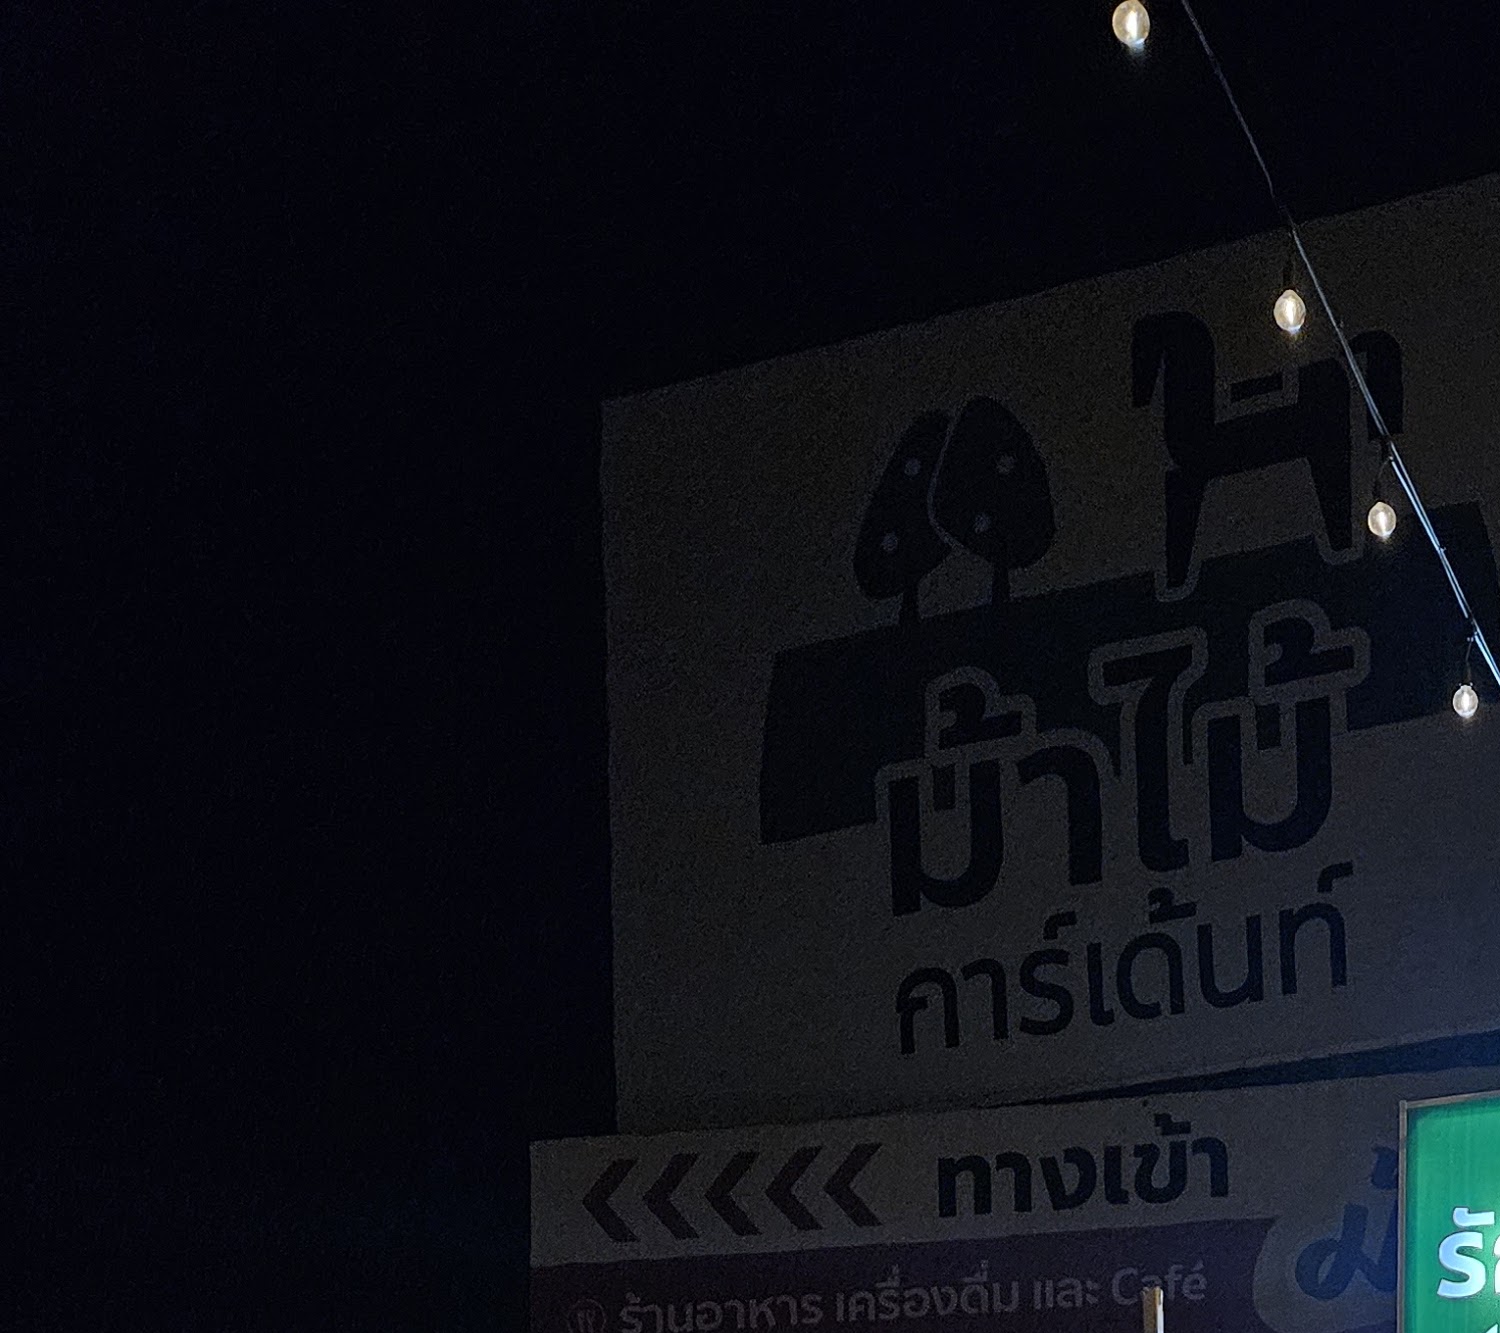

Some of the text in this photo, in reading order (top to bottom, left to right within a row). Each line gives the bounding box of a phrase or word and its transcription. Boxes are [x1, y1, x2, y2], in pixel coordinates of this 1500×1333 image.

[889, 614, 1354, 916] ม้าไม้
[896, 862, 1355, 1054] การ์เด้นท์
[938, 1115, 1230, 1218] ทางเข้า
[836, 1263, 1020, 1323] เครื่องดื่ม
[1034, 1275, 1098, 1310] และ
